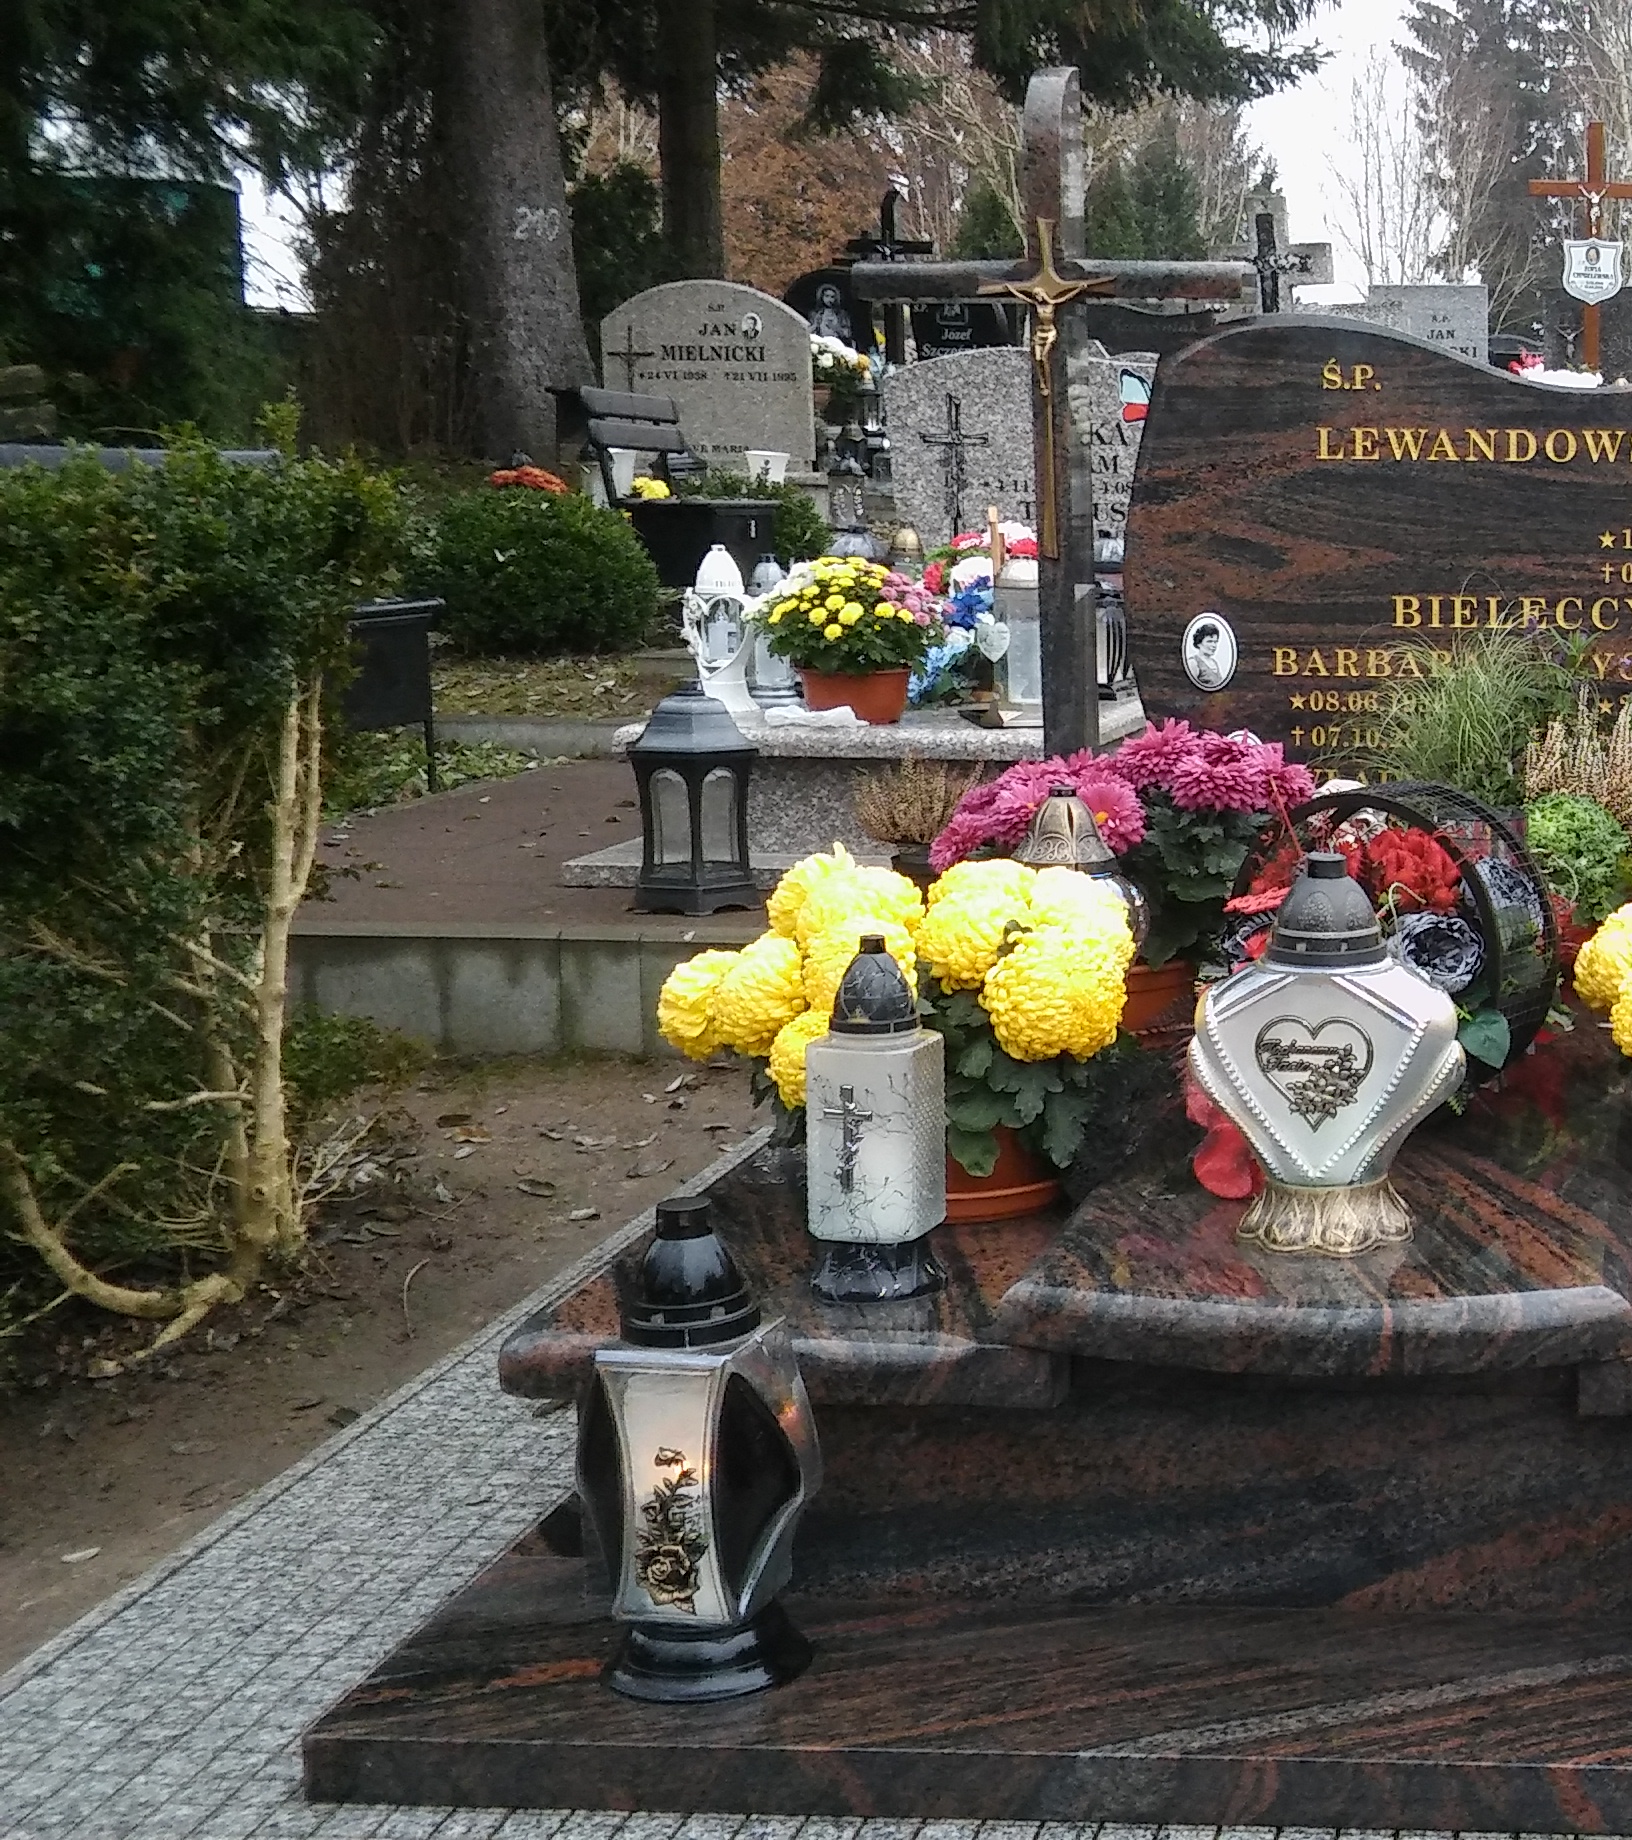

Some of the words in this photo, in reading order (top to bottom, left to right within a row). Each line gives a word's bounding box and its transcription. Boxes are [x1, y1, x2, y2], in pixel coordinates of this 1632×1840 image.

[699, 323, 737, 336] JAN
[1426, 329, 1456, 340] JAN
[660, 344, 766, 362] MIELNICKI
[1321, 357, 1383, 390] Ś.P.
[1272, 647, 1482, 678] BARBAR
